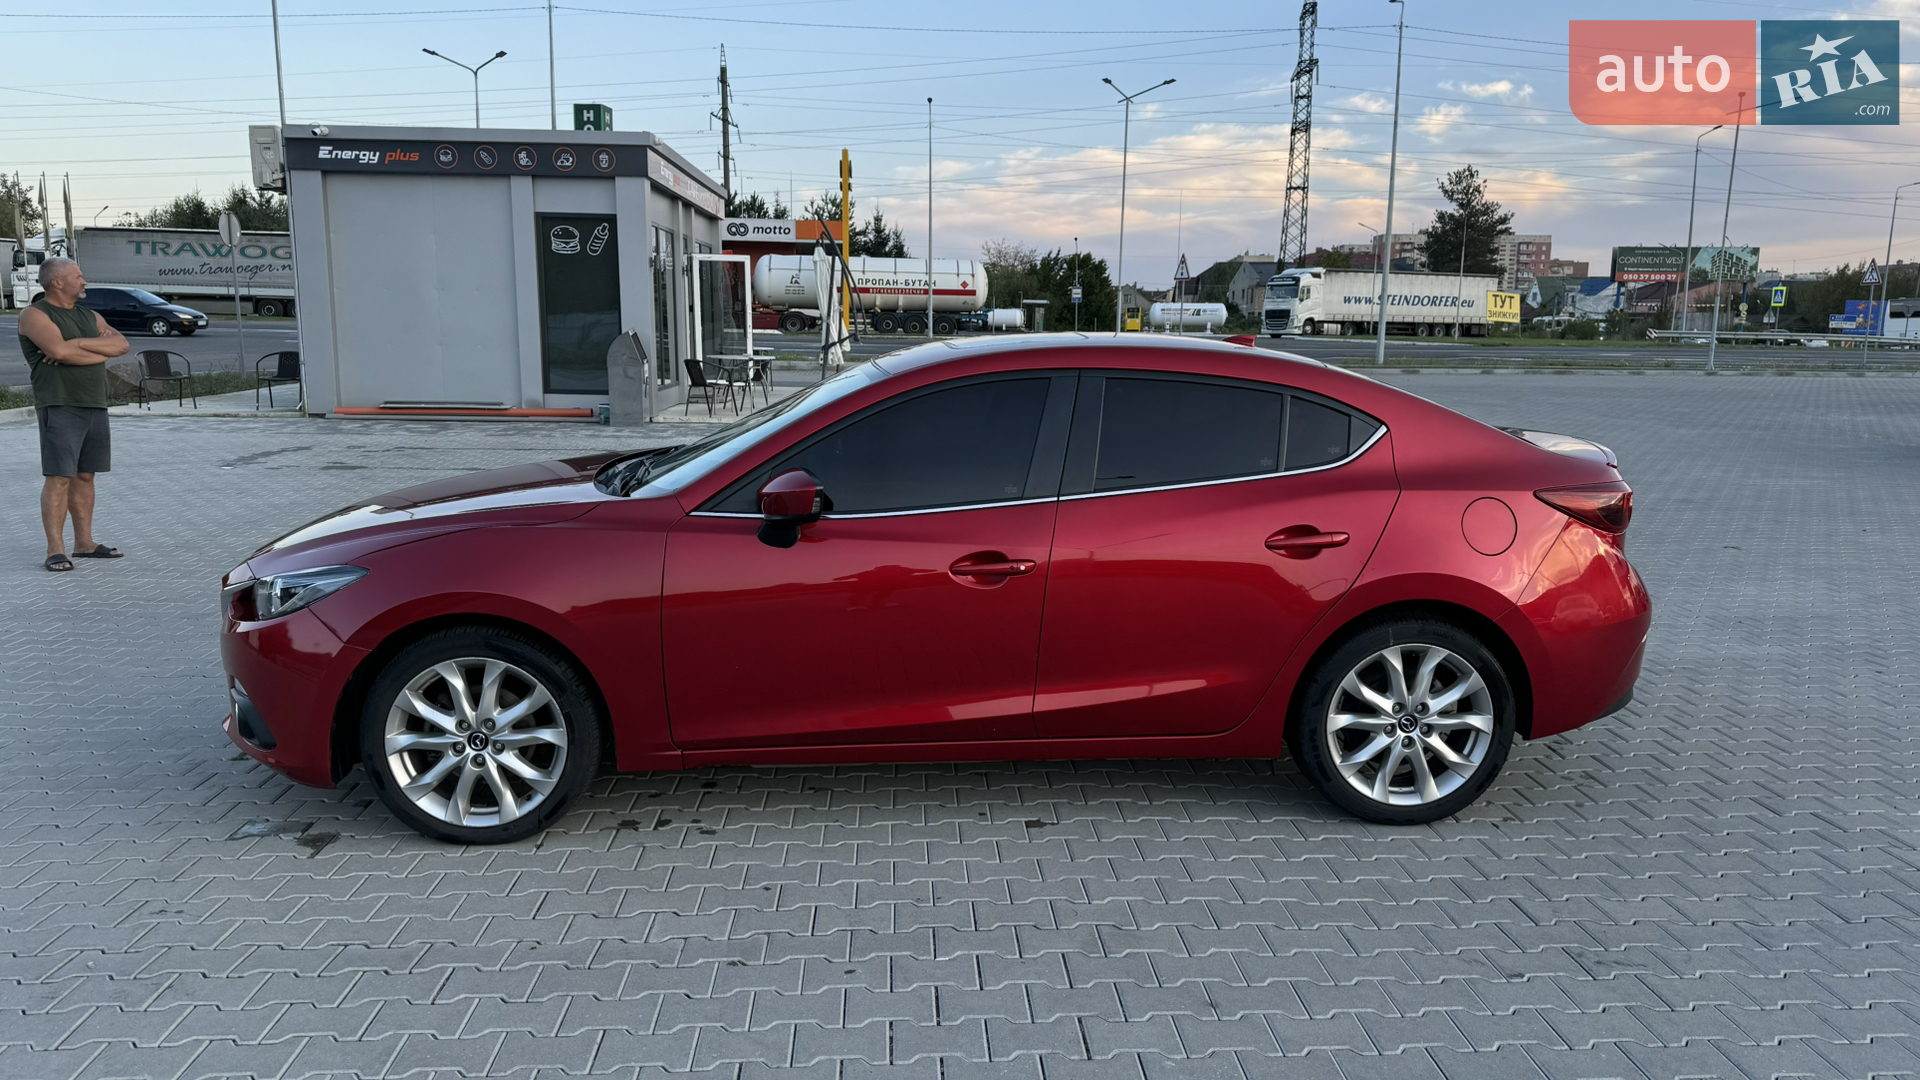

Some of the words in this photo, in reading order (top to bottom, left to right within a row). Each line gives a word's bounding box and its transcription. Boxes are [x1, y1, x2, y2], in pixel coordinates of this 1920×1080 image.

[318, 146, 379, 164] Energy
[385, 148, 419, 164] plus
[752, 226, 791, 235] motto
[1618, 256, 1664, 264] CONTINENT
[1665, 256, 1685, 264] WEST
[857, 278, 937, 287] ПРОПАН-БУТАН
[1343, 294, 1475, 308] www.STEINDORFEReu
[1492, 294, 1515, 309] ТУТ
[1488, 310, 1519, 320] ЗНИЖКИ!
